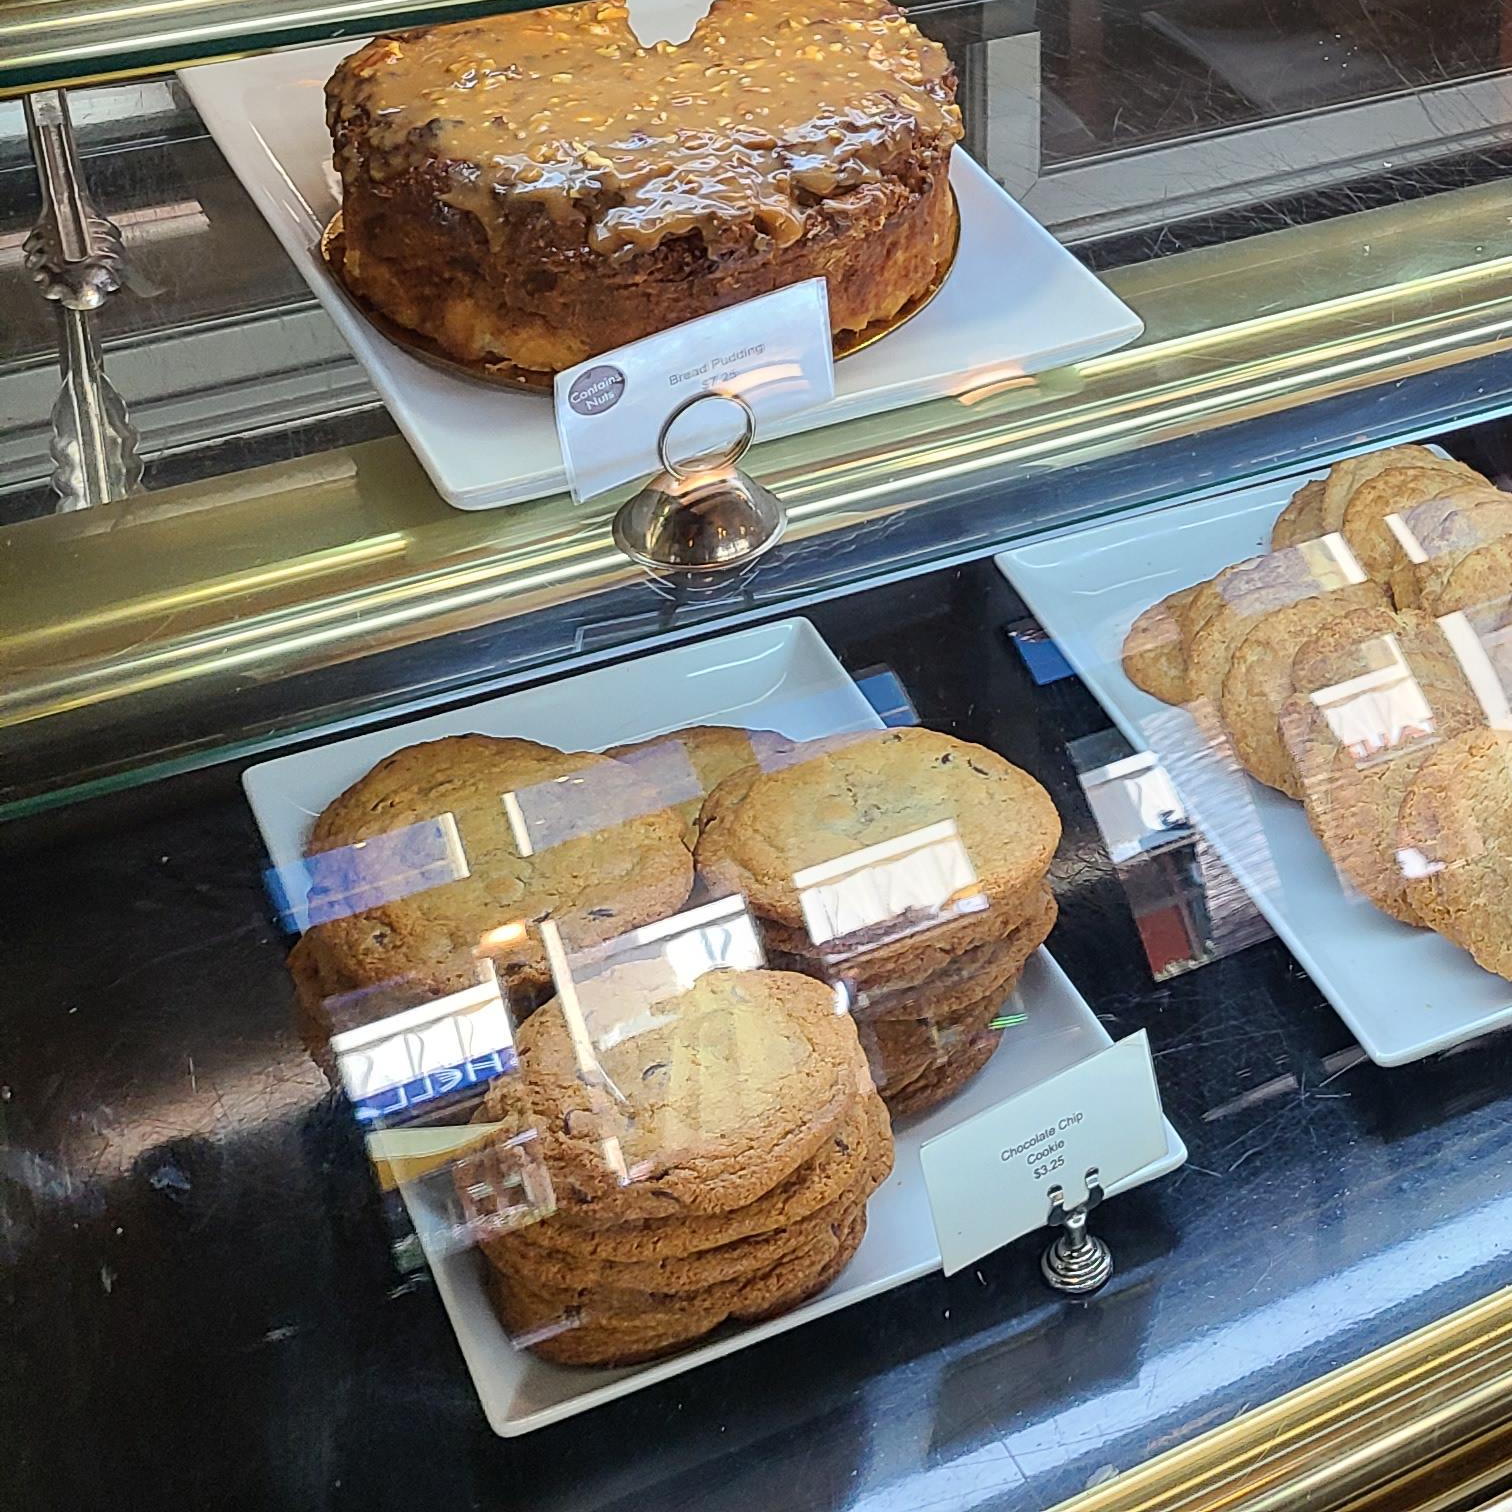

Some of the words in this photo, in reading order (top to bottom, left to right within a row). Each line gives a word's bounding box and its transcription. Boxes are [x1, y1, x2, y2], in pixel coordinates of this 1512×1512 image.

[668, 363, 709, 387] Bread
[711, 343, 767, 372] Pudding
[570, 373, 623, 404] Contains
[585, 389, 615, 411] Nuts
[1000, 1125, 1056, 1163] Chocolate
[1058, 1110, 1084, 1132] Chip
[1026, 1139, 1065, 1166] Cookie
[1033, 1155, 1065, 1180] $3.25
